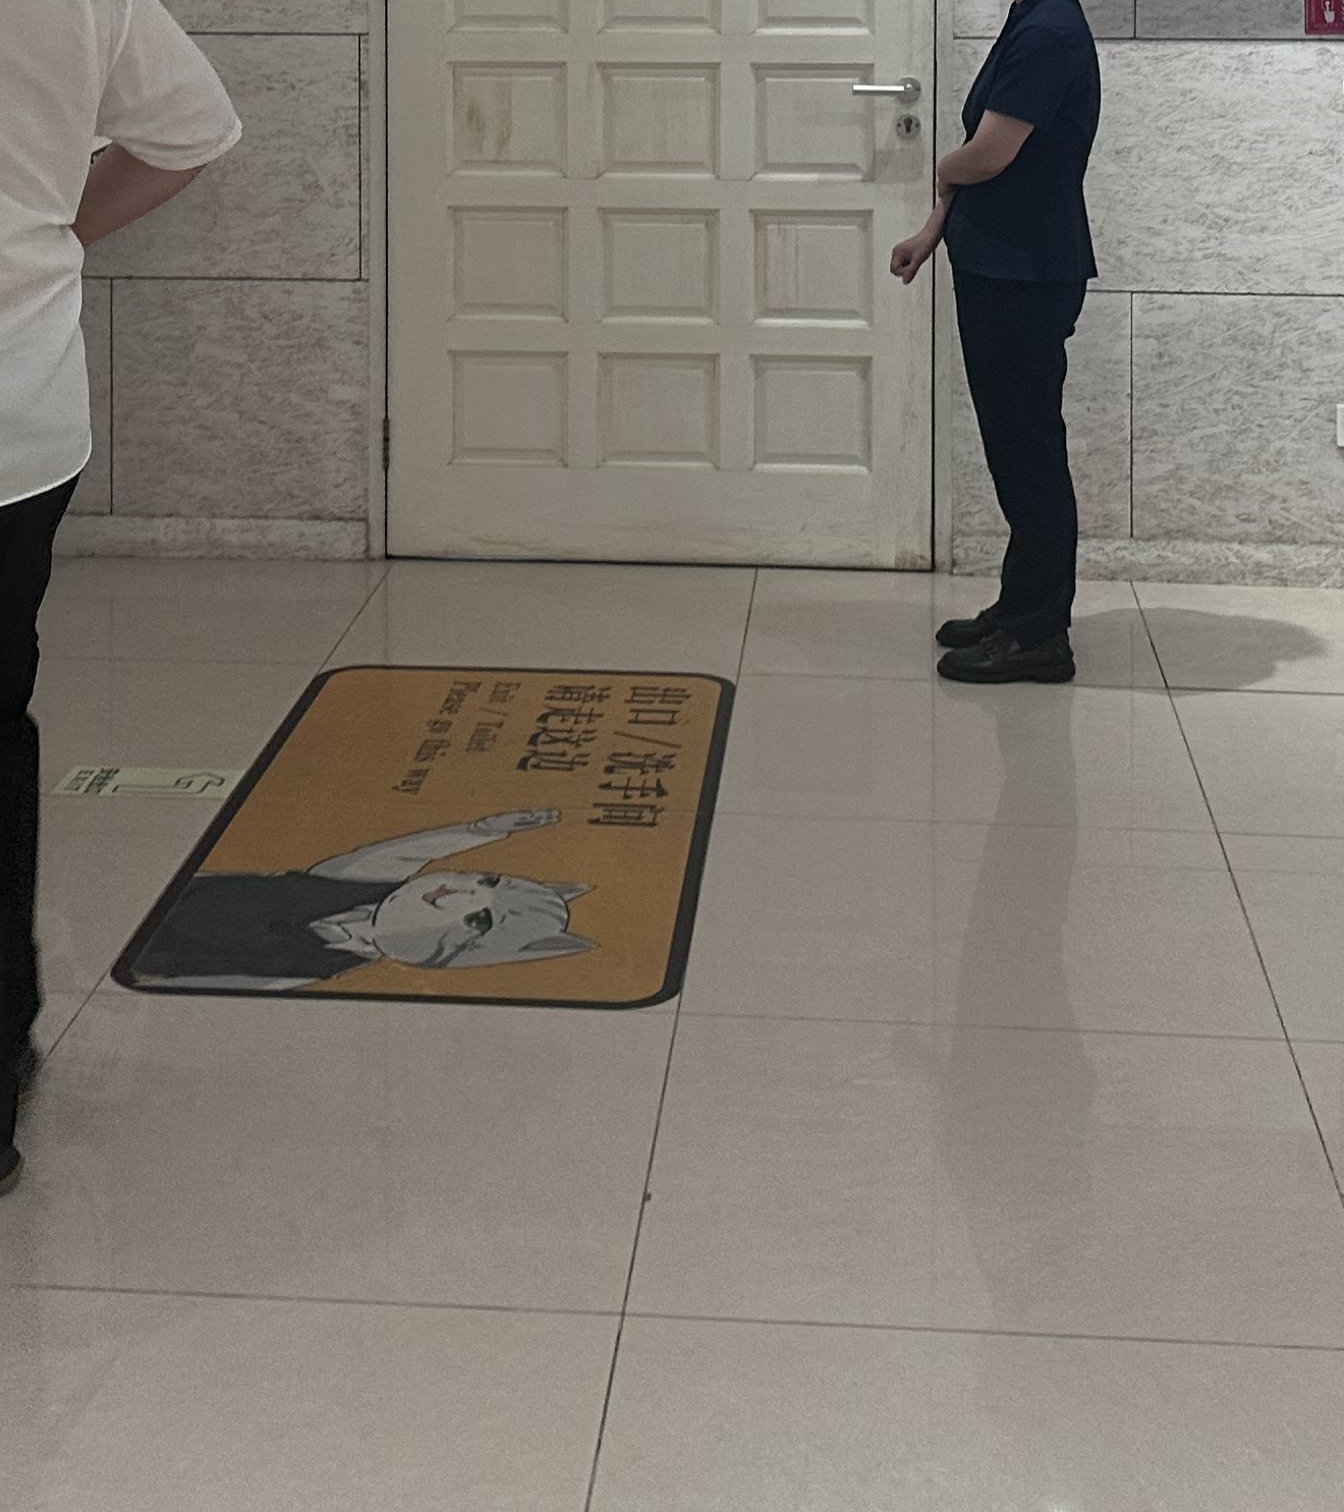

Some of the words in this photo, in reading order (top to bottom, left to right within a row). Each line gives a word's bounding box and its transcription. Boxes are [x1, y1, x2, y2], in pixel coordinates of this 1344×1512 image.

[439, 680, 483, 715] Please
[426, 718, 453, 733] go
[516, 685, 613, 772] 请走这边
[414, 738, 451, 763] this
[392, 769, 430, 795] way
